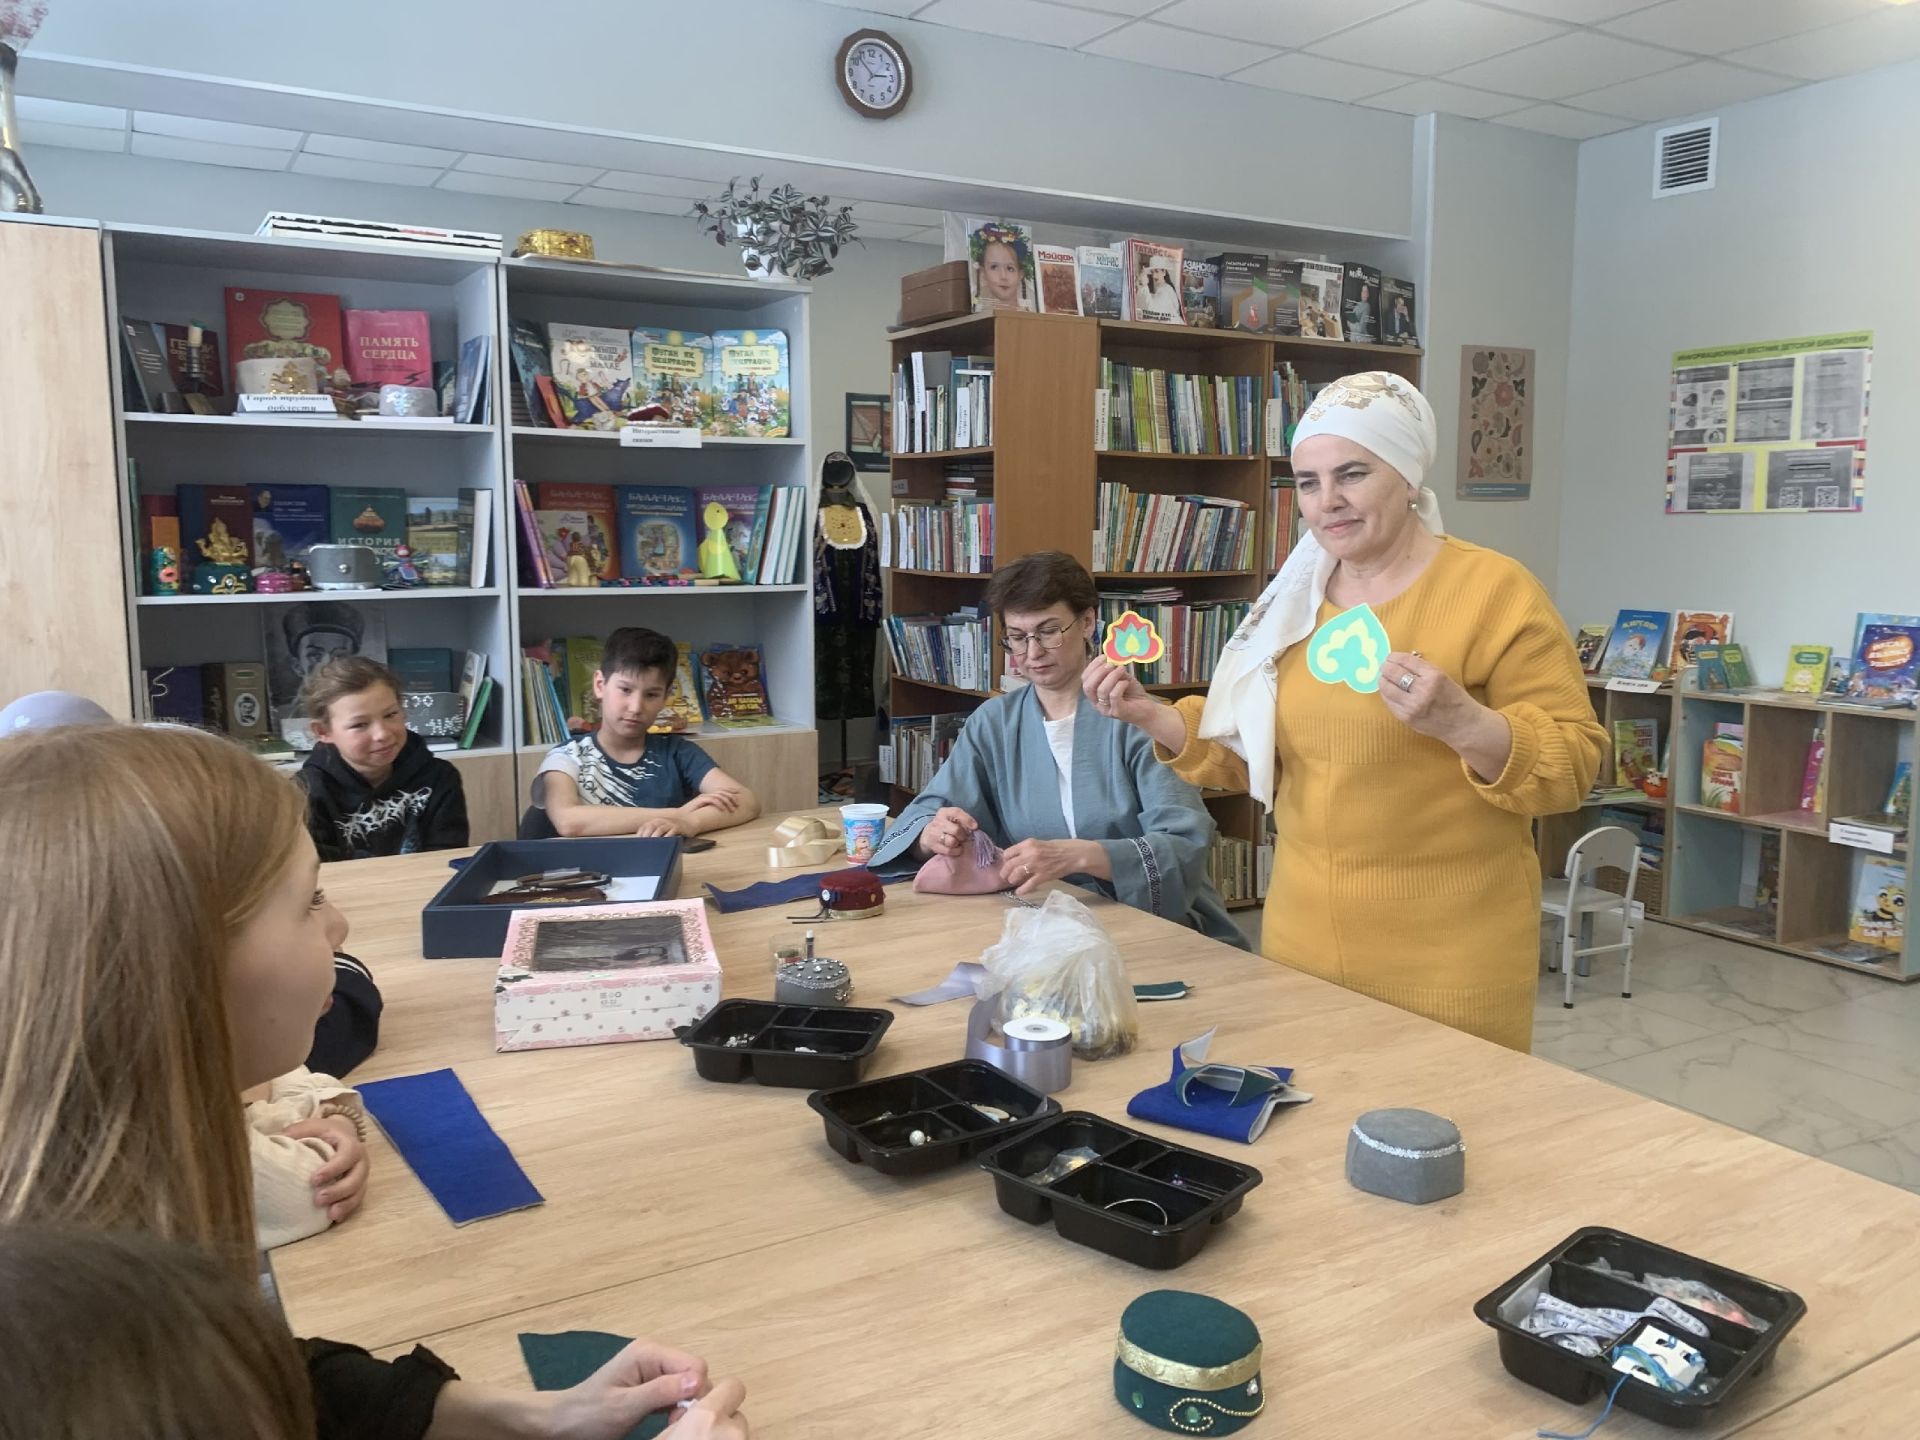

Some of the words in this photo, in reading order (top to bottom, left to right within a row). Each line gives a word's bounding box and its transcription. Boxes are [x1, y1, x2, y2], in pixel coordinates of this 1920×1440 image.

[867, 49, 876, 58] 12
[879, 54, 883, 62] 1
[851, 57, 859, 66] 10
[886, 63, 890, 71] 2
[849, 68, 854, 77] 9
[889, 75, 894, 83] 3
[853, 81, 857, 89] 8
[861, 89, 865, 98] 7
[869, 94, 875, 102] 6
[880, 92, 885, 101] 5
[360, 337, 419, 347] ПАМЯТЬ
[362, 350, 416, 360] СЕРДЦА
[338, 537, 400, 546] ИСТОРИЯ
